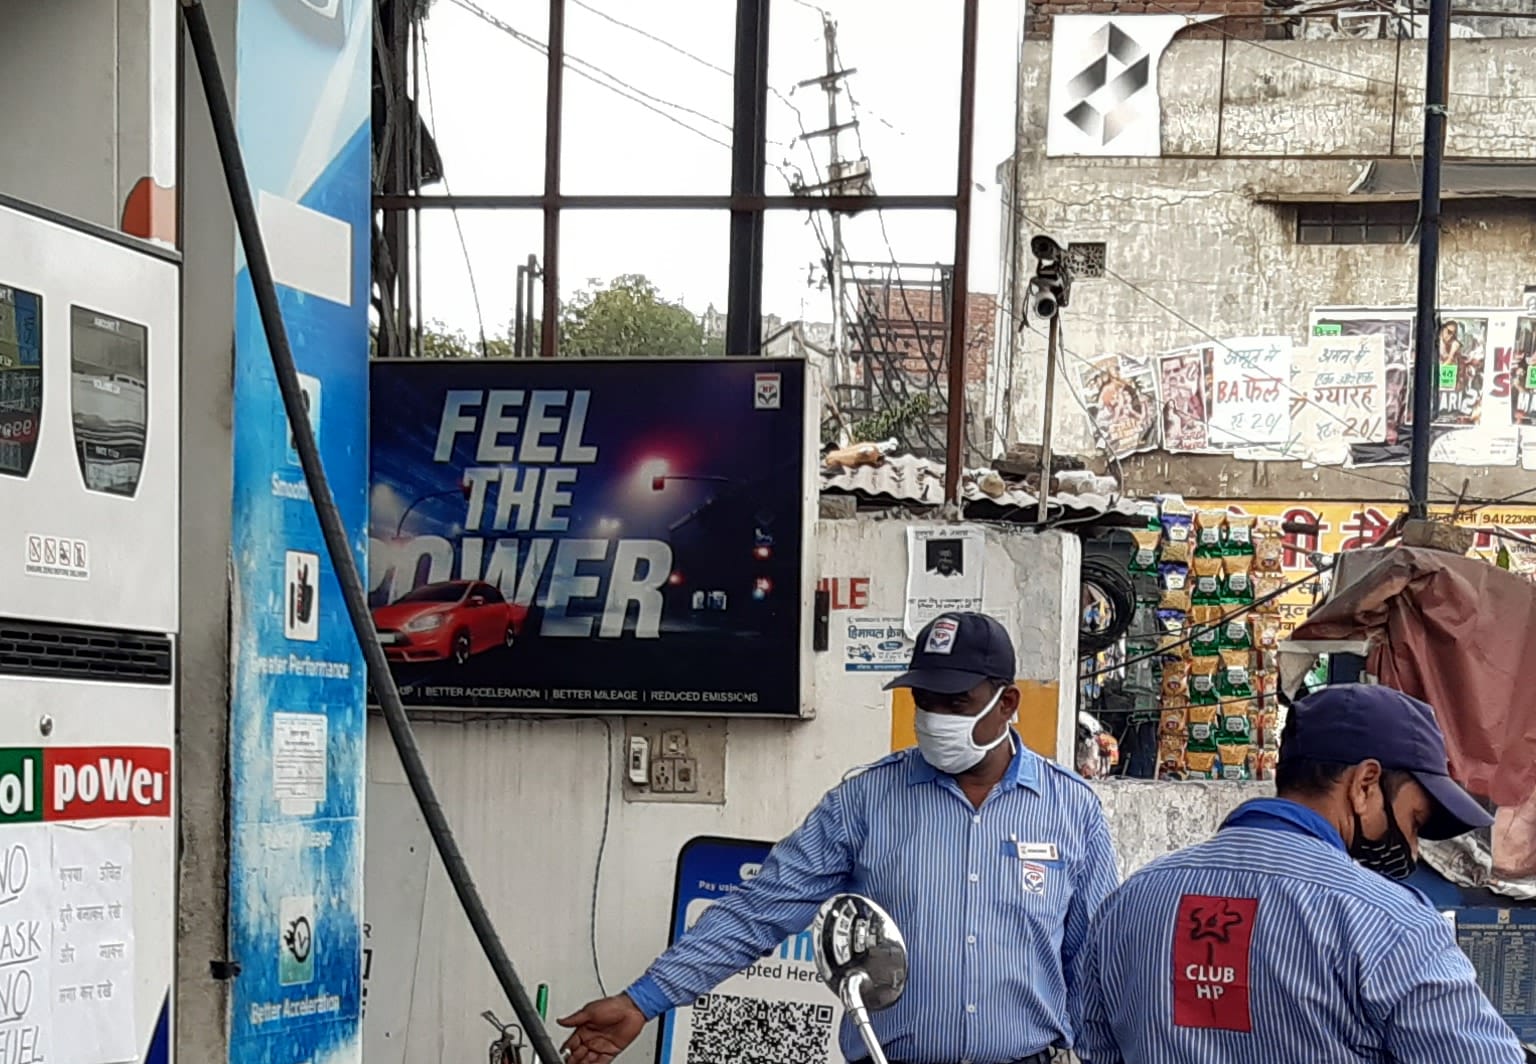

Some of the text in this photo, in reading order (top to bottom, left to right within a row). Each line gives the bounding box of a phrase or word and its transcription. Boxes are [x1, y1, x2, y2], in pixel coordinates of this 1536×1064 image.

[434, 390, 598, 463] FEEL
[464, 467, 577, 531] THE
[289, 654, 350, 679] Performance
[425, 687, 759, 703] BETTER ACCELERATION BETTER MILEAGE REDUCED EMISSIONS
[698, 880, 716, 892] Pay
[786, 968, 824, 983] Here
[1186, 965, 1235, 983] CLUB
[1196, 984, 1224, 1000] HP
[251, 993, 340, 1024] Better Acceleration
